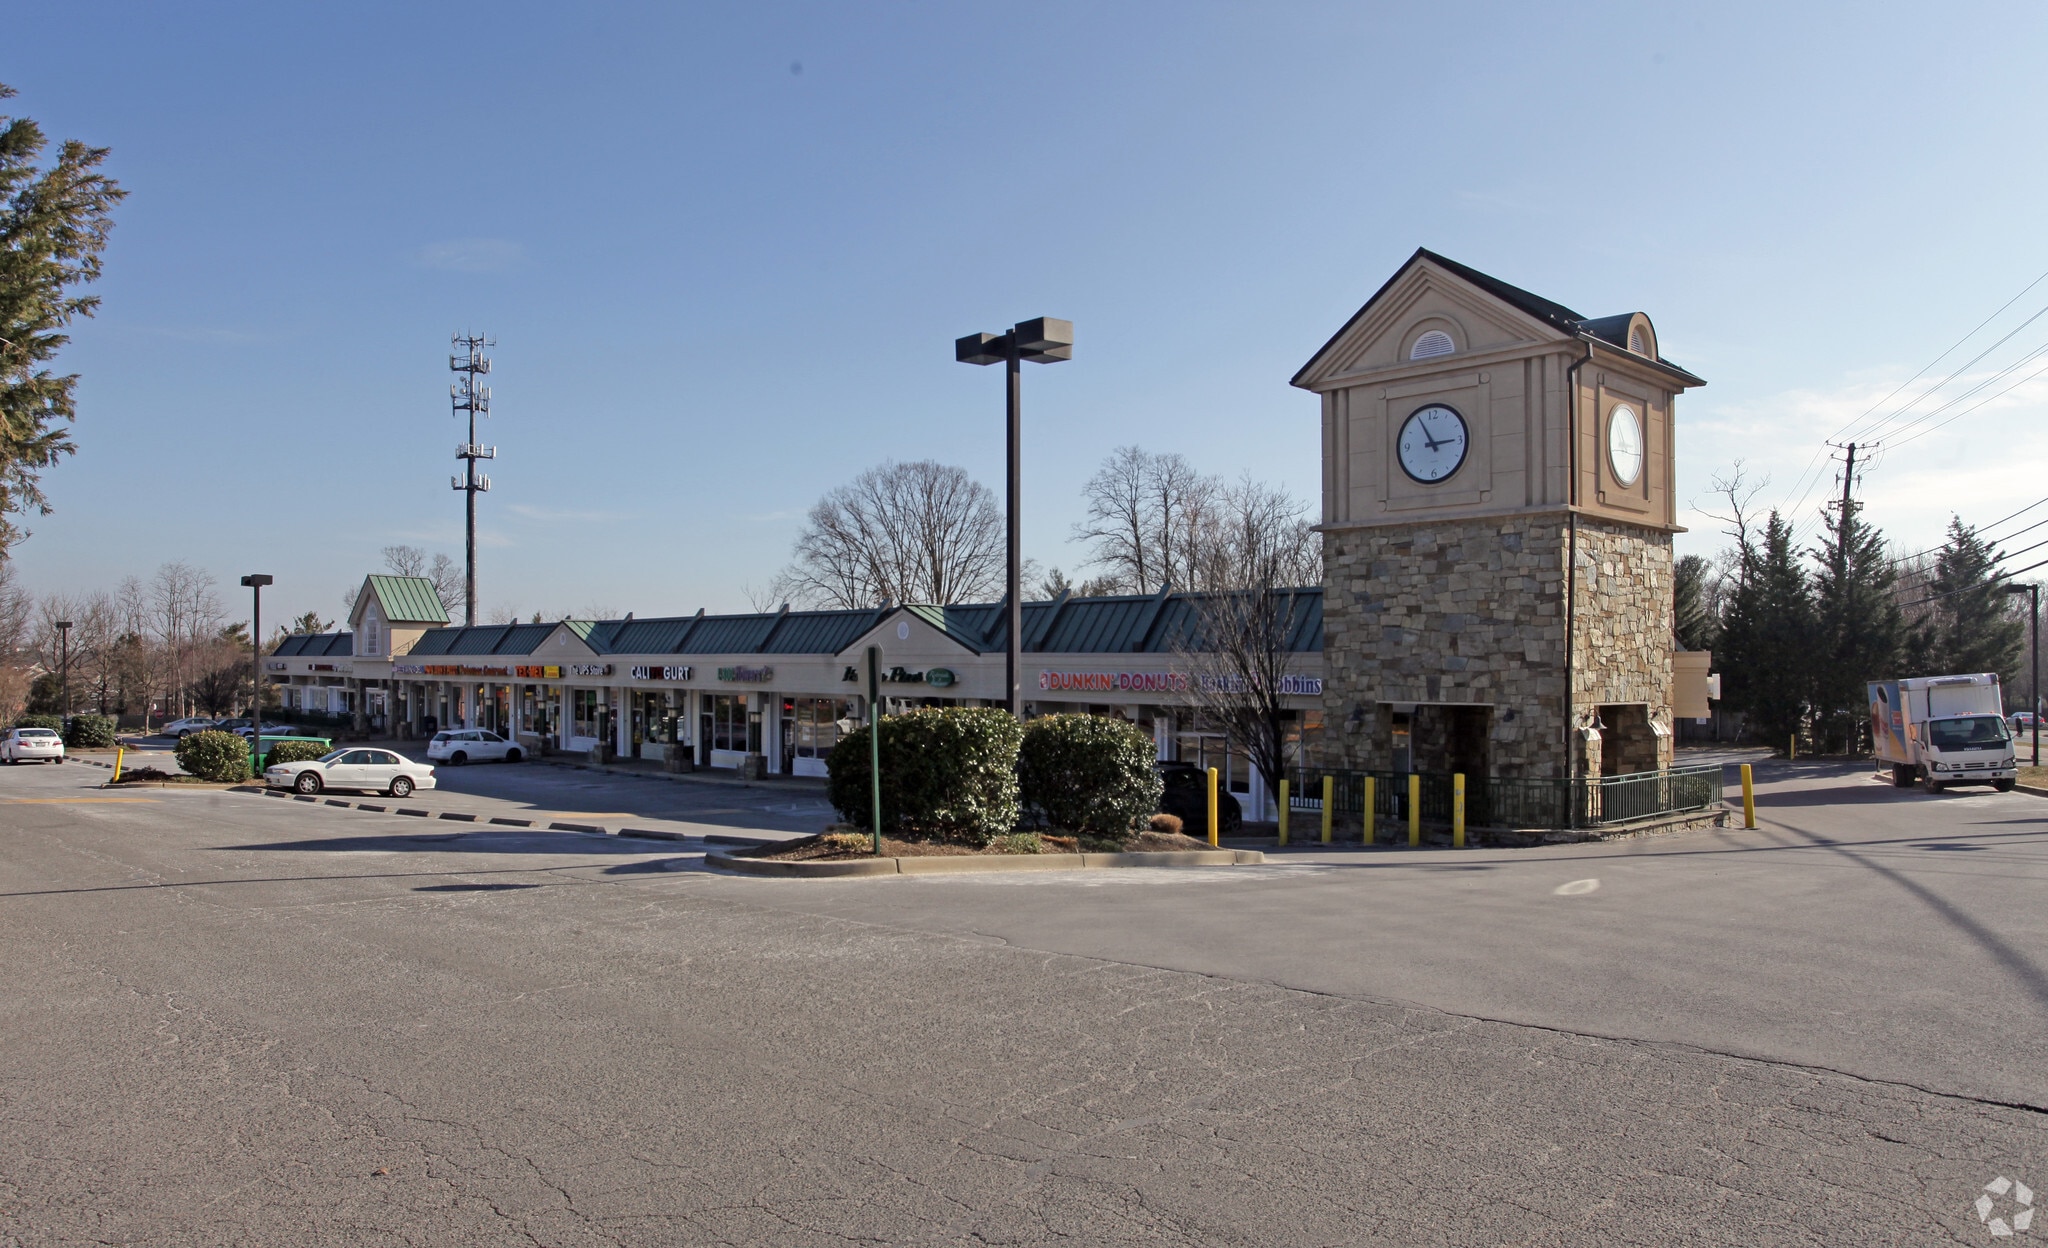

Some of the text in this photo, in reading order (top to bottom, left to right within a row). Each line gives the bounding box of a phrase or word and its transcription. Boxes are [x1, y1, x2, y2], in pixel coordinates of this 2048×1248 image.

[1428, 410, 1438, 420] 12
[1457, 435, 1463, 445] 3
[1404, 443, 1411, 452] 9
[1431, 468, 1437, 478] 6
[1049, 672, 1188, 691] DUNKIN' DONUTS
